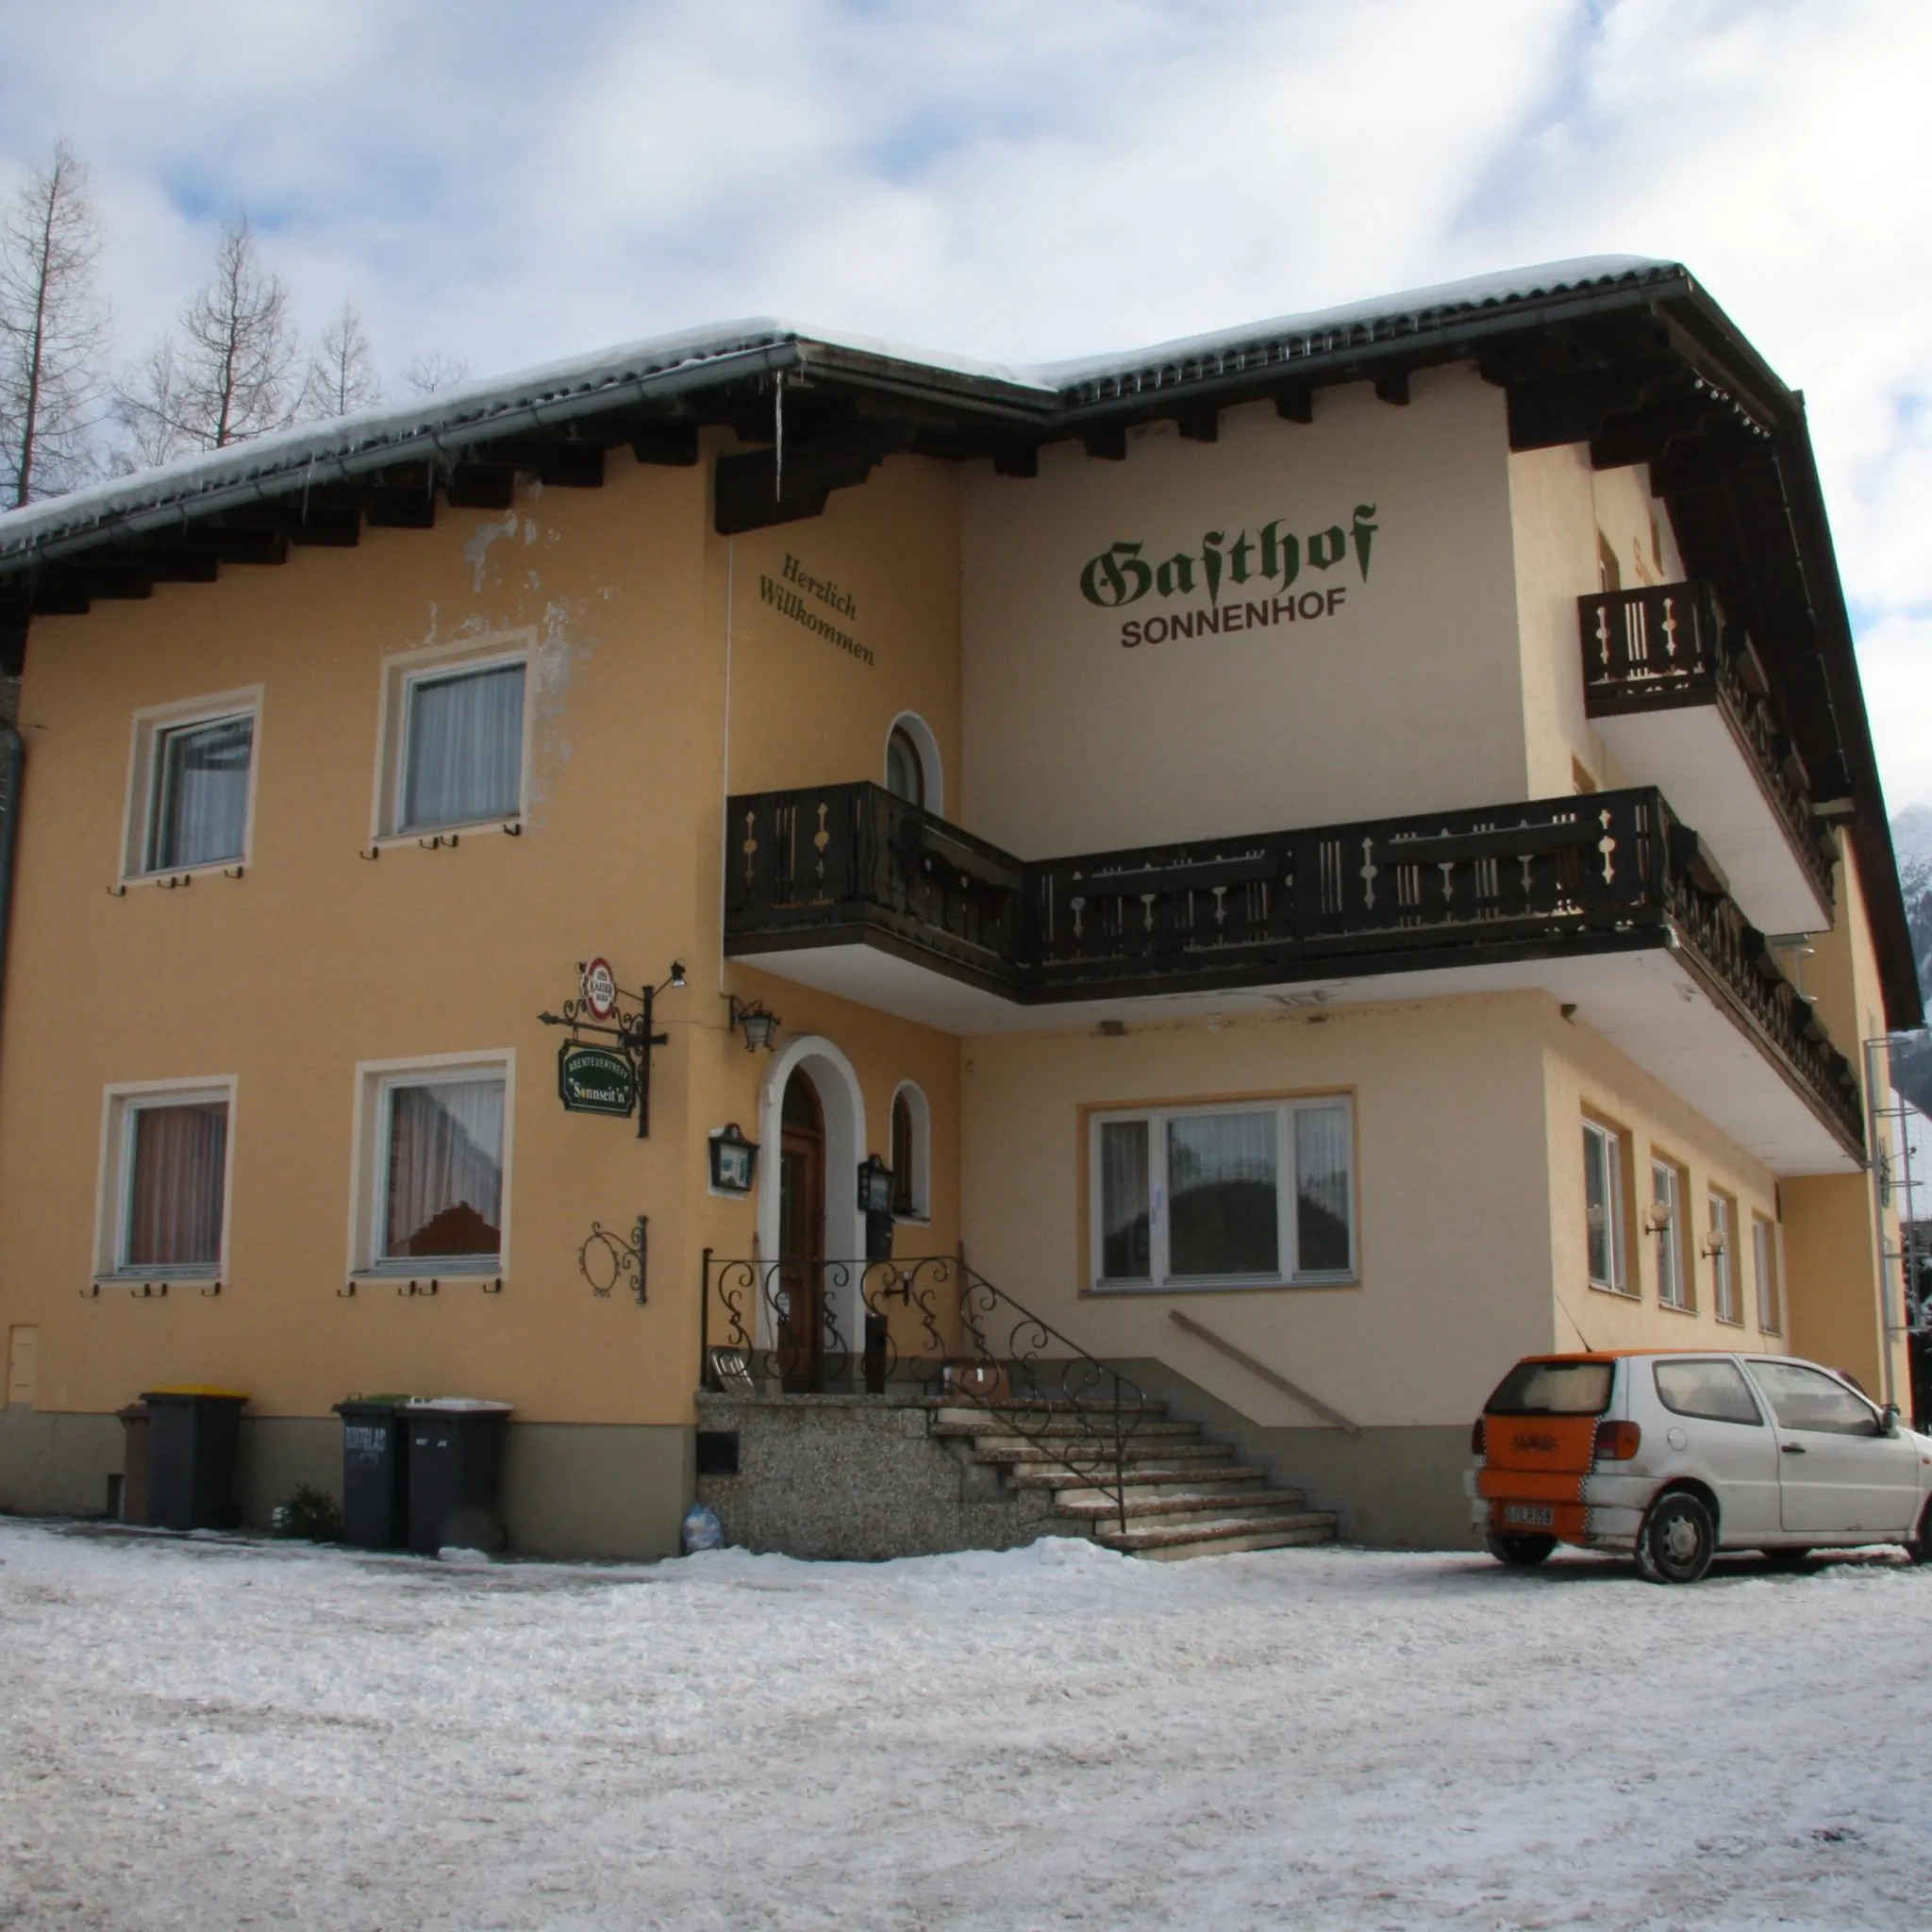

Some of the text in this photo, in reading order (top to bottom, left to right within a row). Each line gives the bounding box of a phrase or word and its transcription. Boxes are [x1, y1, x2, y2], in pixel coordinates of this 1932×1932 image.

[760, 574, 874, 667] Willkommen
[781, 553, 857, 621] Herzlich
[1121, 587, 1346, 648] SONNENHOF
